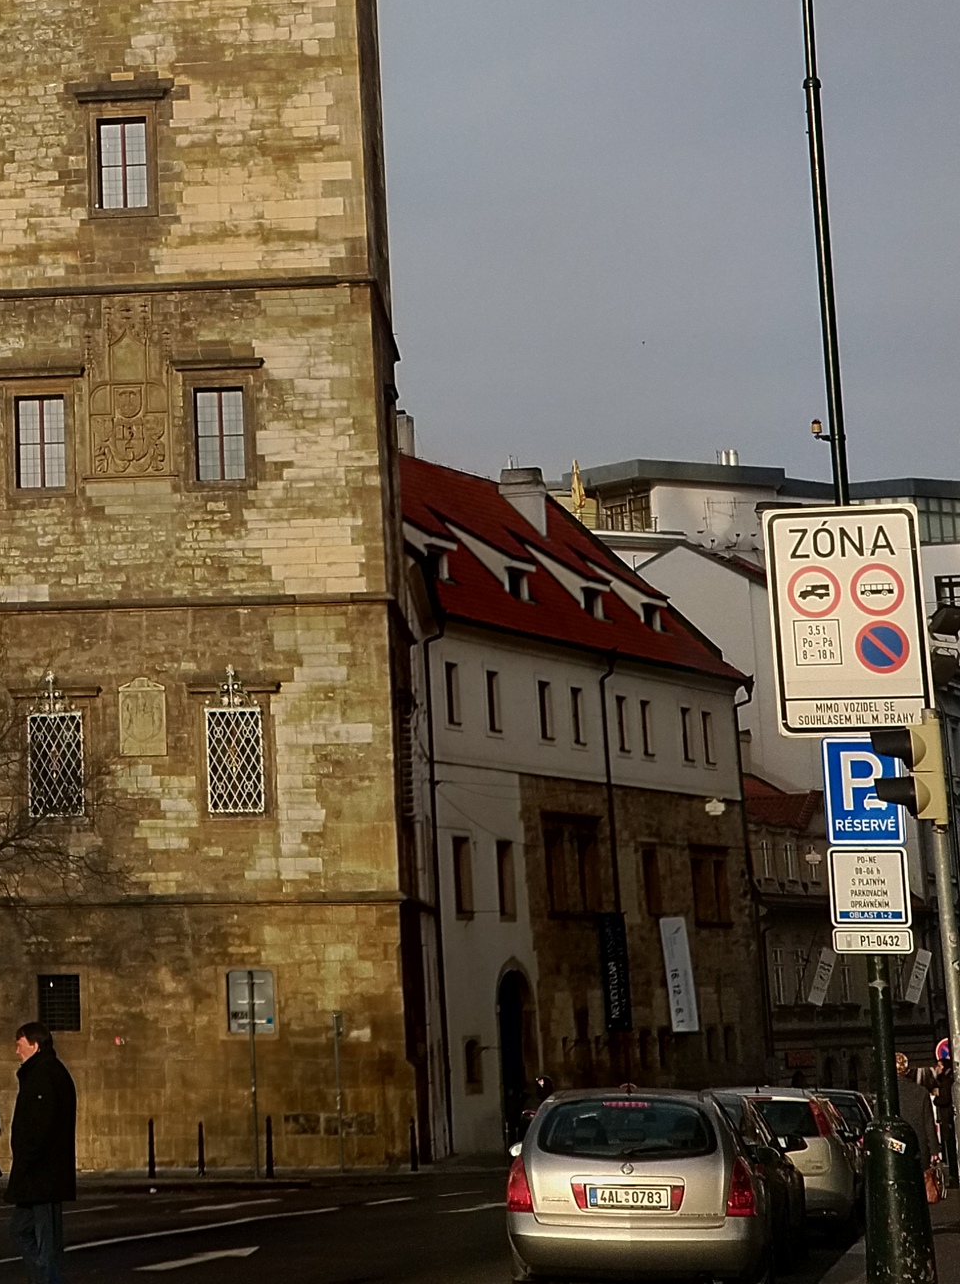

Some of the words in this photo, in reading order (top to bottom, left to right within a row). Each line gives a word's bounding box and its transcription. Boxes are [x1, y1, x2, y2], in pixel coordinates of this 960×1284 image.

[788, 520, 896, 559] ZÓNA
[808, 625, 821, 636] 3,5
[802, 637, 813, 648] Po
[822, 636, 833, 647] Pá
[802, 649, 808, 660] 8
[817, 649, 827, 660] 18
[829, 649, 835, 659] h
[815, 702, 840, 713] MIMO
[843, 701, 880, 713] VOZIDEL
[883, 701, 896, 712] SE
[798, 714, 852, 726] SOUHLASEM
[884, 712, 915, 724] PRAHY
[840, 751, 883, 811] P
[835, 816, 896, 831] RÉSERVÉ
[857, 855, 877, 864] PO-NE
[851, 877, 856, 886] S
[858, 875, 886, 886] PLATNÝM
[850, 887, 889, 897] PARKOVACÍM
[849, 911, 878, 919] OBLAST
[860, 935, 901, 947] P1-0432
[600, 1190, 622, 1204] 4AL
[631, 1191, 662, 1204] 0783
